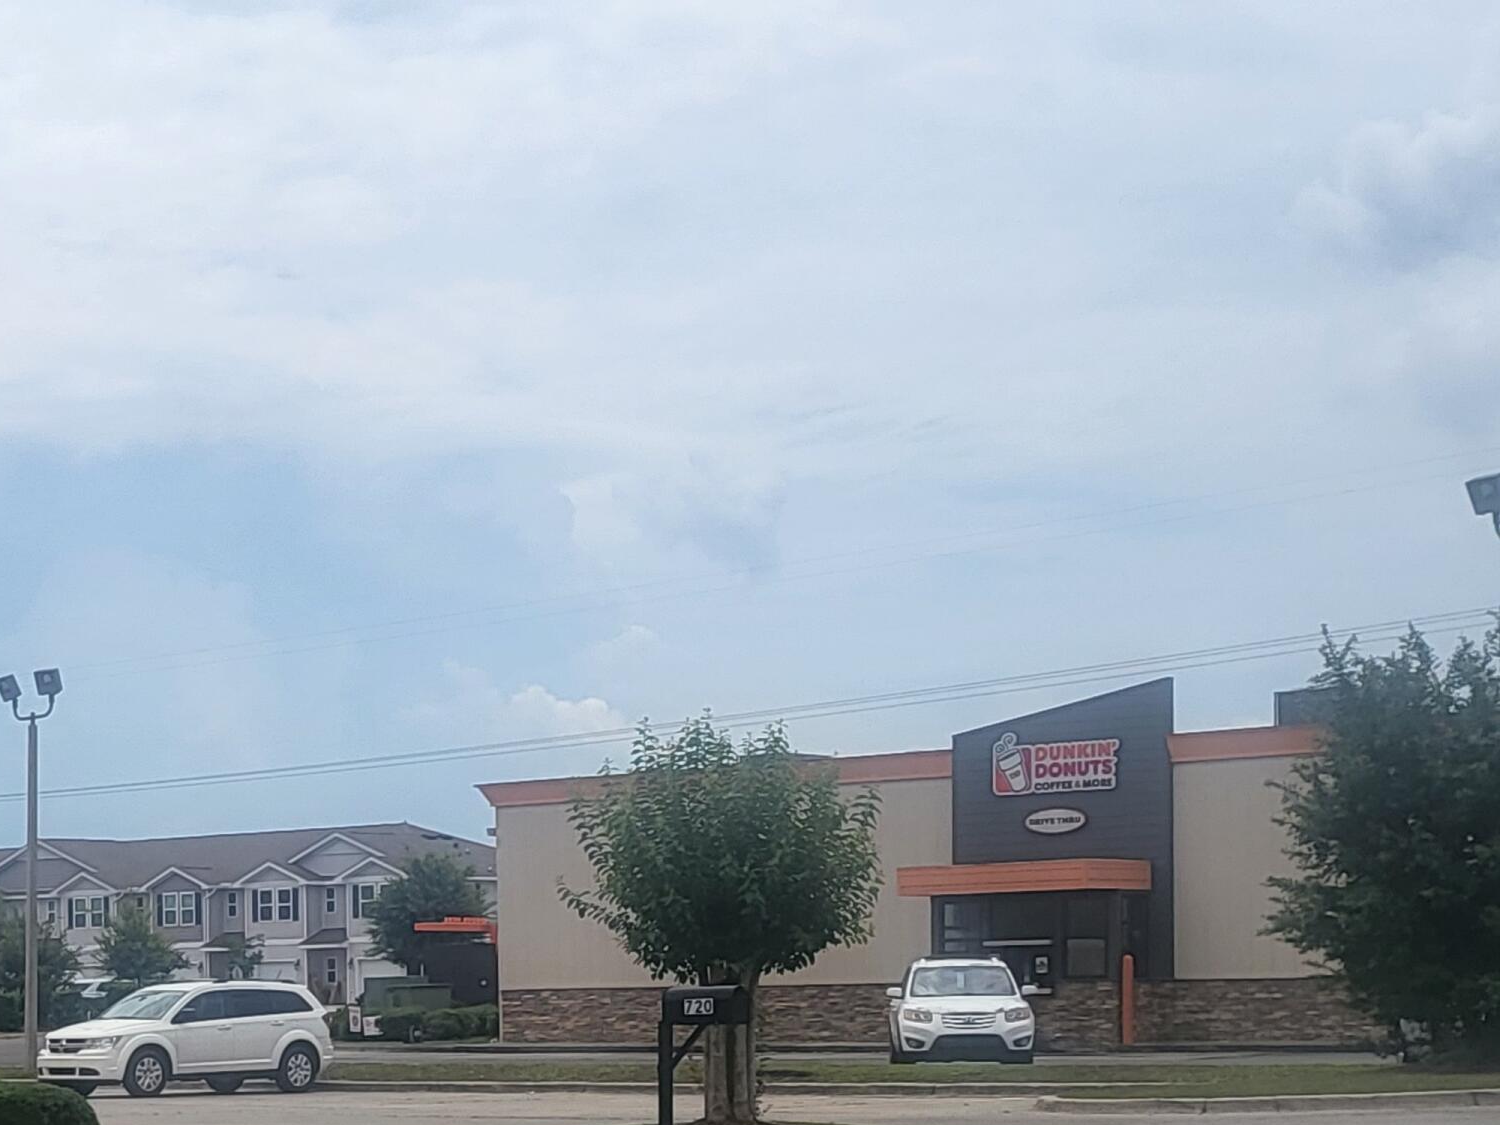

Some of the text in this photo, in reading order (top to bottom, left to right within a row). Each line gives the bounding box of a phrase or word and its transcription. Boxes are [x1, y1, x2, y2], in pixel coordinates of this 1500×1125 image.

[1035, 741, 1117, 761] DUNKIN'
[1035, 759, 1113, 779] DONUTS
[1034, 780, 1072, 791] COFFEE
[1082, 778, 1112, 788] MORE
[685, 1000, 712, 1013] 720
